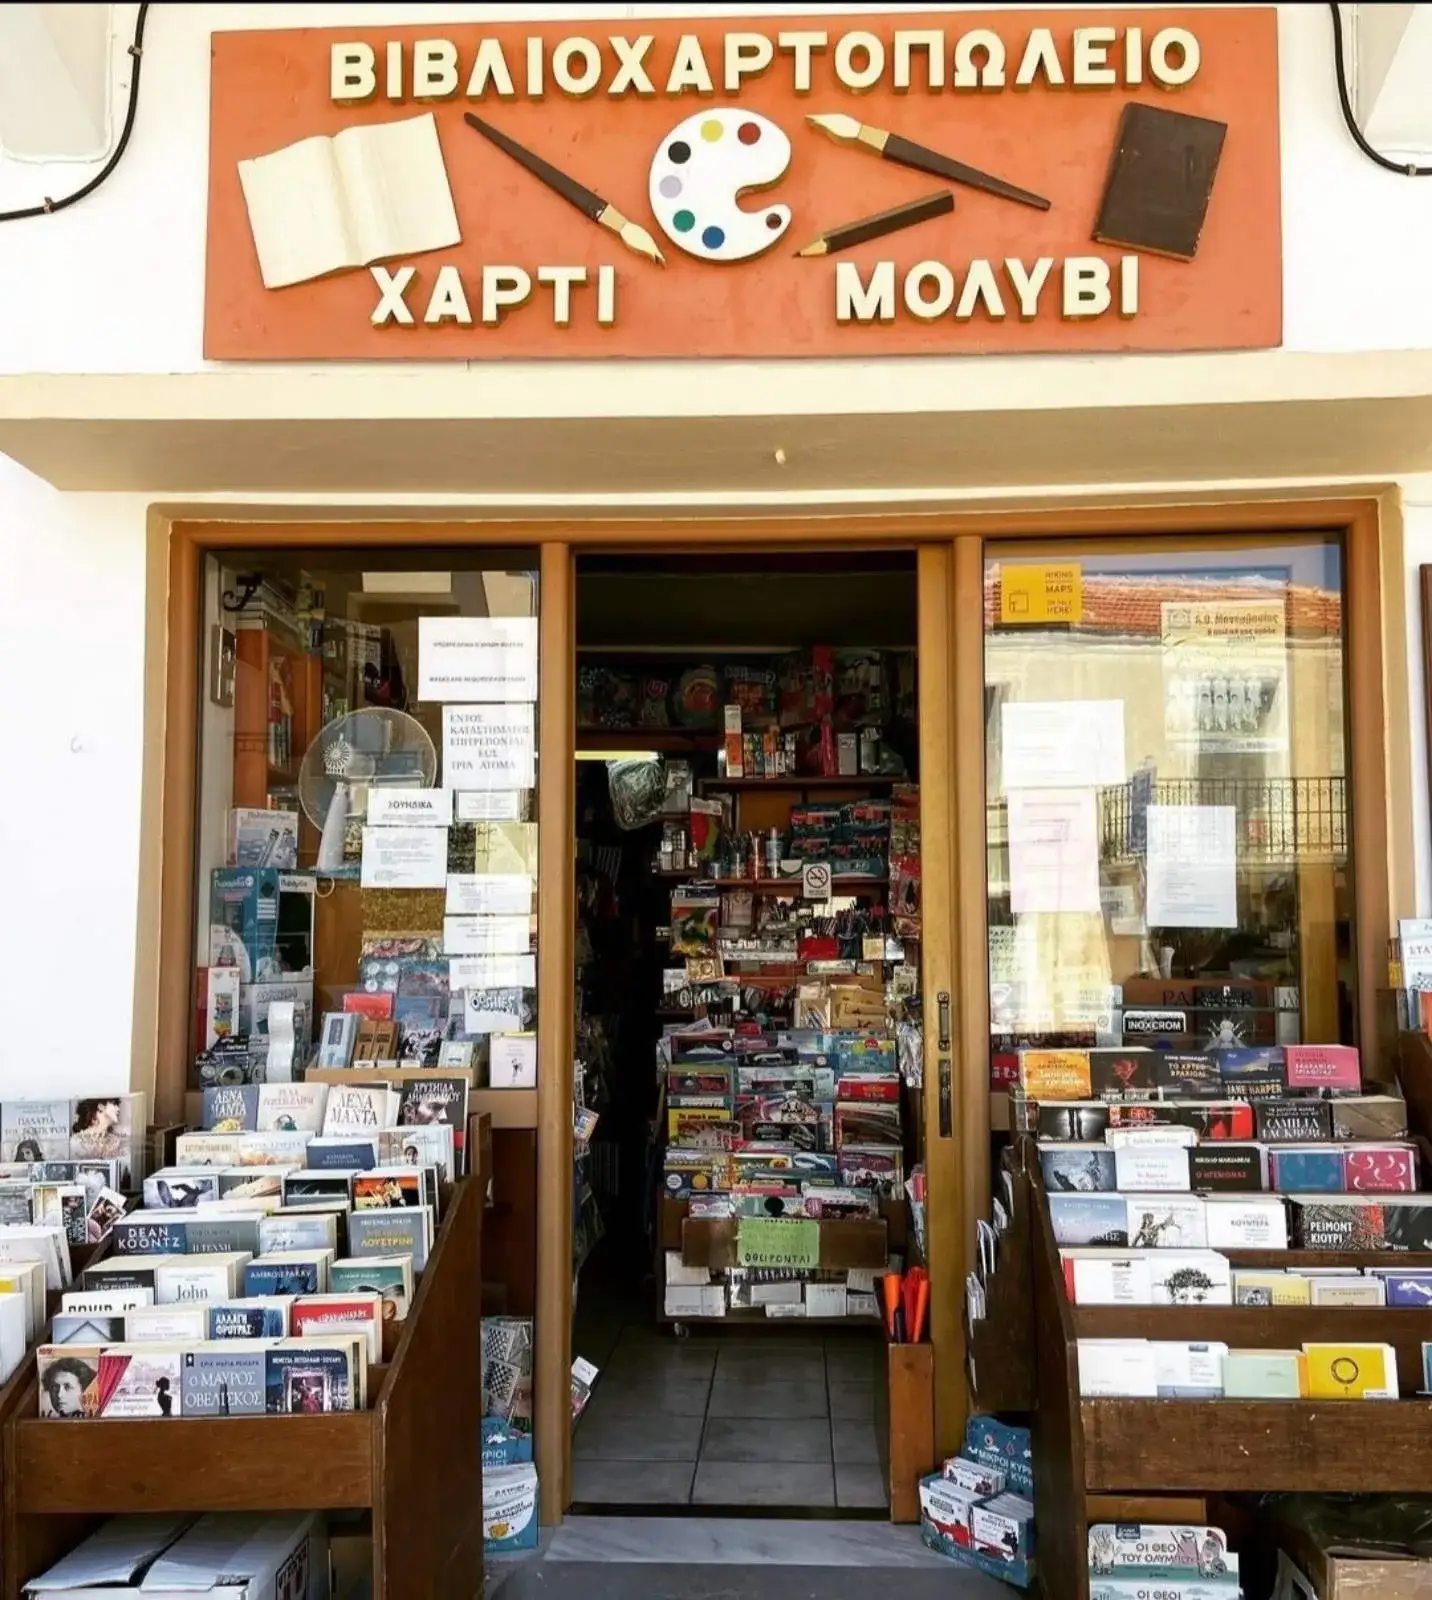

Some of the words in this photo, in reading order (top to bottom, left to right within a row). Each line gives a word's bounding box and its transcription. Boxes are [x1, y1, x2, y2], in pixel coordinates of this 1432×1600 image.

[329, 27, 1202, 101] ΒΙΒΛΙΟΧΑΡΤΟΠΩΛΕΙΟ
[834, 254, 1141, 324] ΜΟΛΥΒΙ
[370, 263, 618, 327] ΧΑΡΤΙ
[1045, 584, 1073, 593] MAPS
[450, 712, 483, 723] ΕΝΤΟΣ
[451, 760, 474, 770] ΤΡΙΑ
[479, 759, 516, 770] ΑΤΟΜΑ
[1128, 1020, 1181, 1031] INOXCROM
[1227, 1085, 1246, 1095] JANE
[1249, 1084, 1282, 1095] HARPER
[331, 1107, 377, 1125] ΜΑΝΤΑ
[128, 1227, 168, 1238] DEAN
[1311, 1233, 1343, 1243] ΚΙΟΥΡΙ
[118, 1236, 180, 1249] KOONTZ
[176, 1285, 208, 1302] John
[215, 1314, 247, 1324] ΑΛΛΑΓΗ
[201, 1371, 256, 1386] ΜΑΥΡΟΣ
[184, 1391, 262, 1408] ΟΒΕΛΙΣΚΟΣ
[1136, 1543, 1148, 1553] ΟΙ
[1121, 1553, 1141, 1563] ΤΟΥ
[1137, 1591, 1149, 1600] ΟΙ
[1153, 1591, 1181, 1600] ΘΕΟΙ
